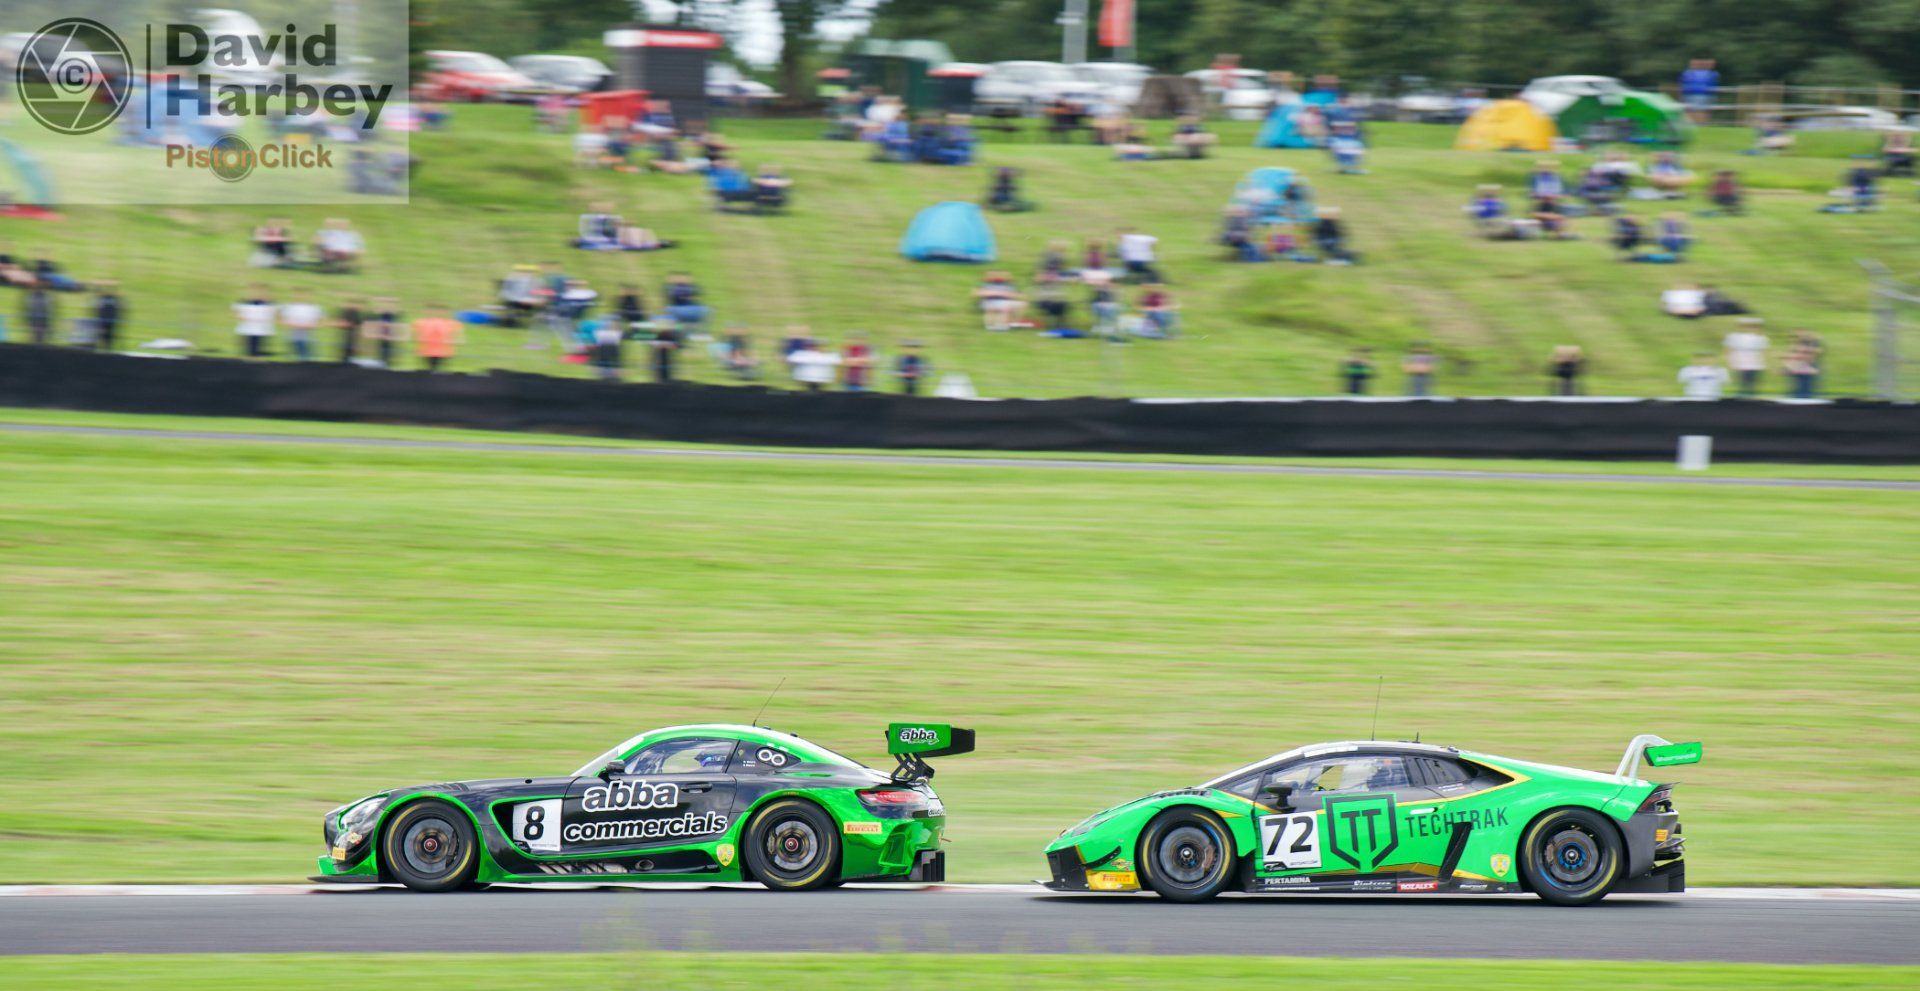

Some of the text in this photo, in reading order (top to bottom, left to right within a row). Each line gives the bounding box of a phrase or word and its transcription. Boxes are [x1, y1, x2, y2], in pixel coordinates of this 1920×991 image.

[900, 728, 937, 742] abba
[582, 780, 679, 812] abba
[523, 805, 545, 841] 8
[564, 811, 728, 842] commercials
[1264, 815, 1314, 856] 72
[1404, 806, 1509, 838] TECHTRAK
[1264, 876, 1311, 885] PERTAMINA
